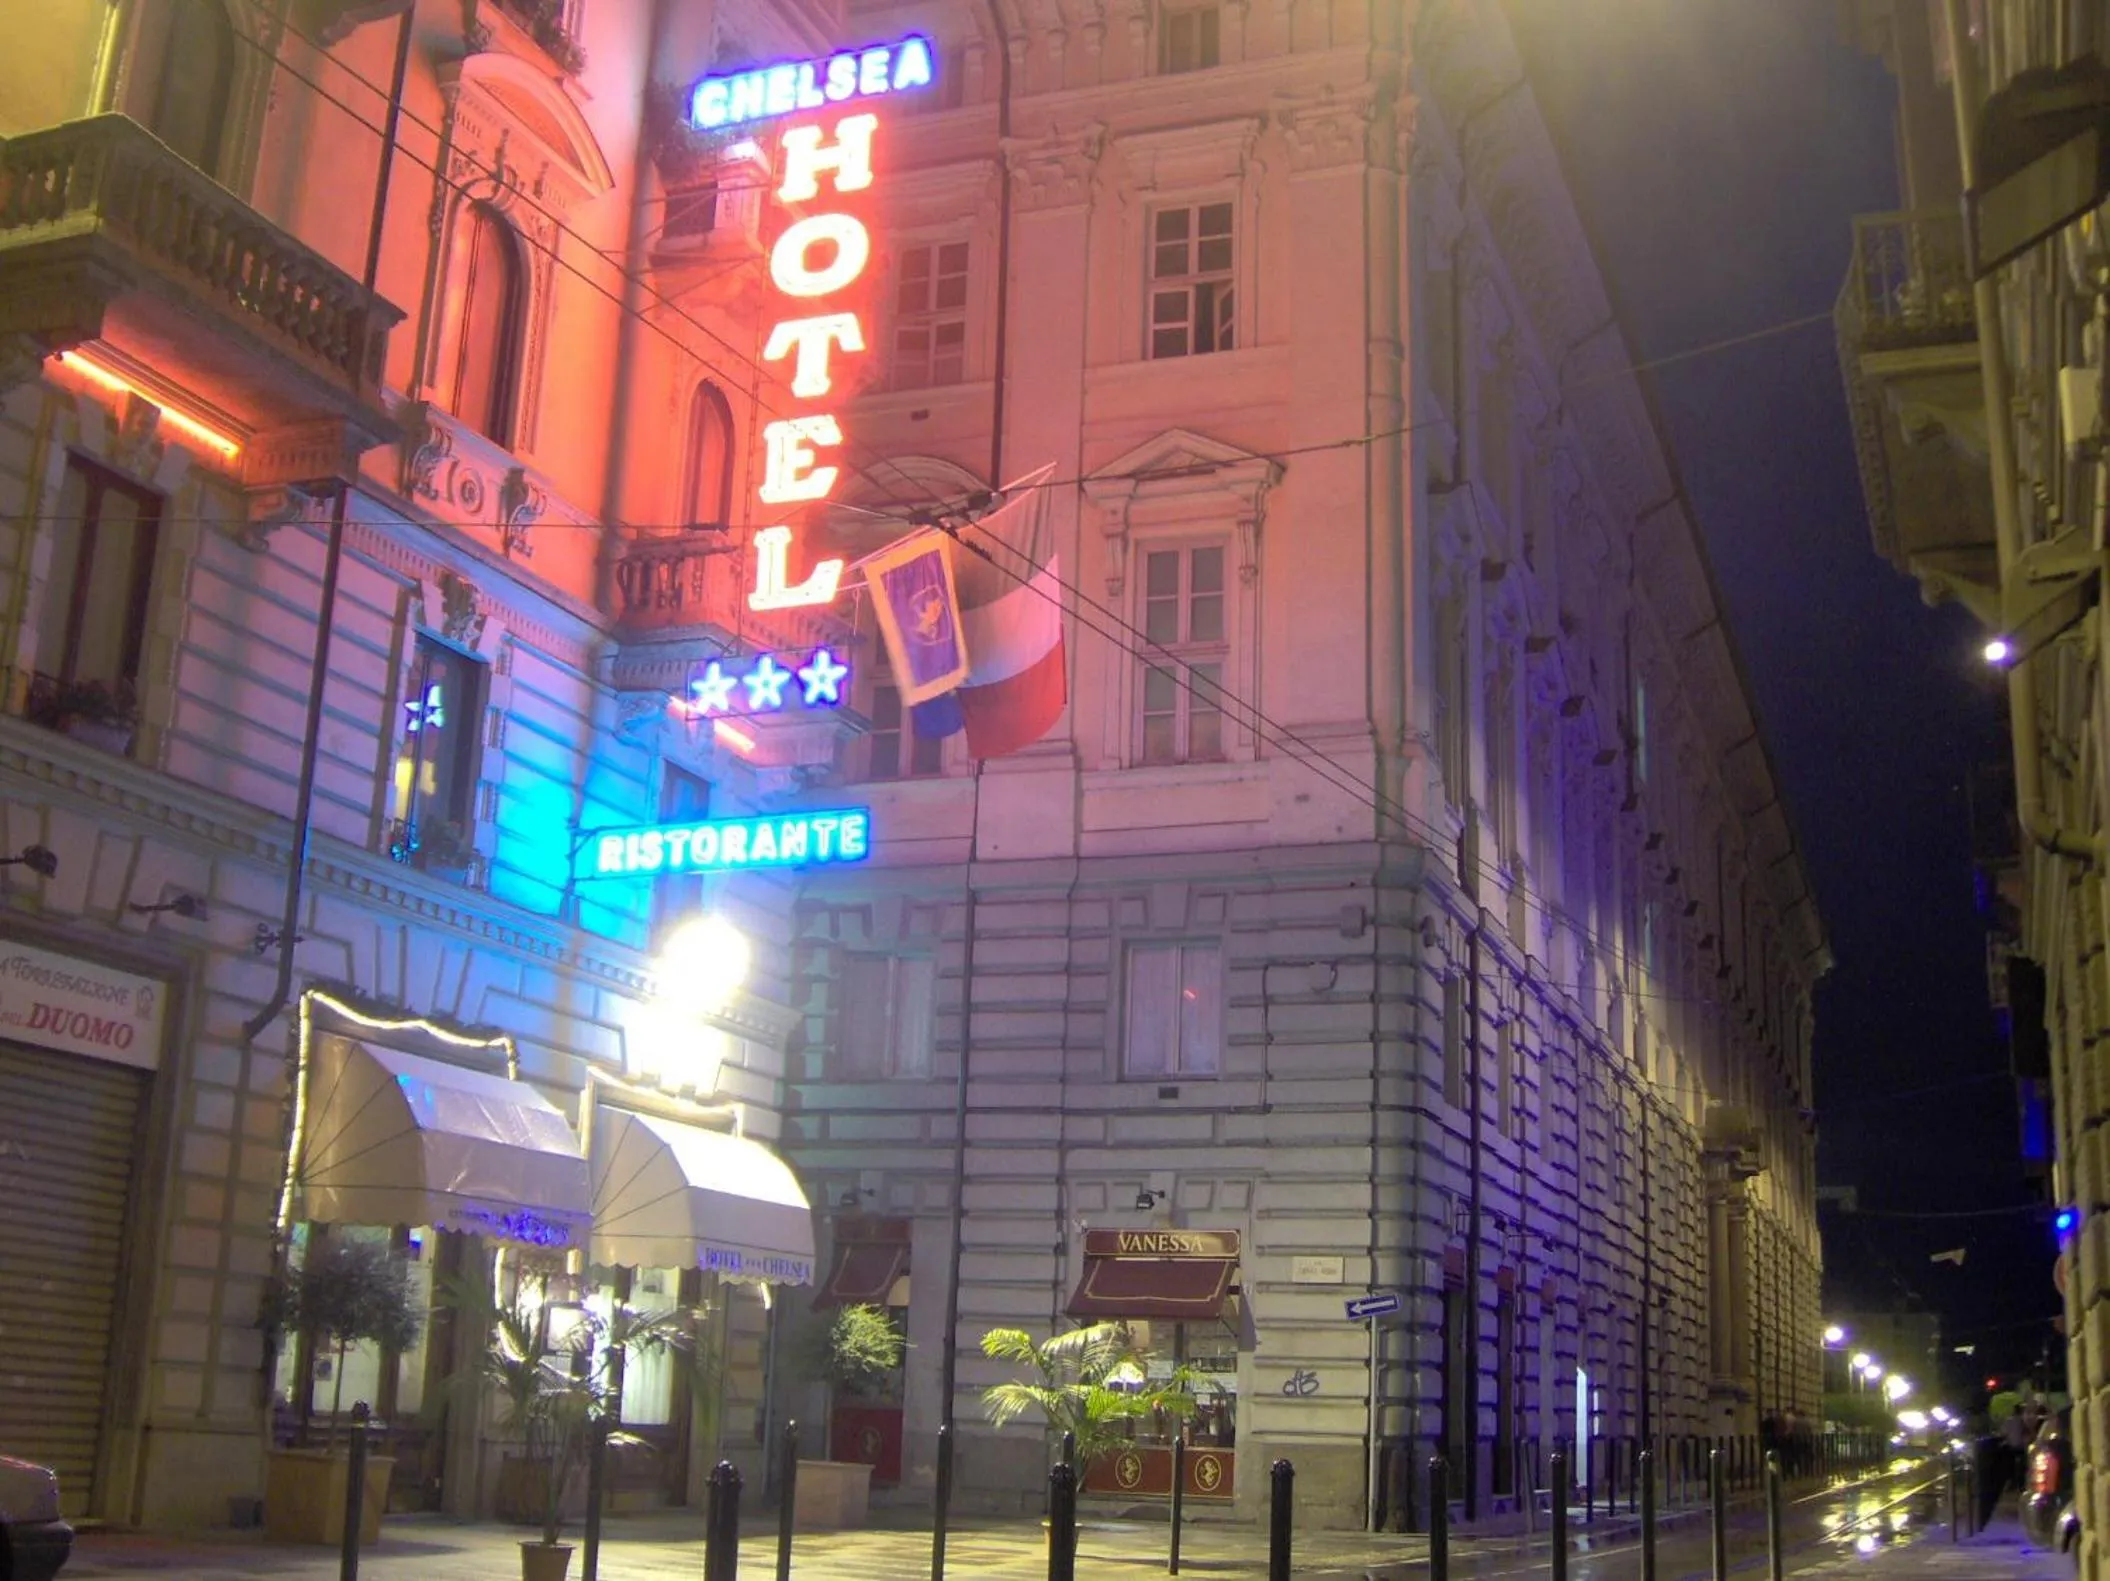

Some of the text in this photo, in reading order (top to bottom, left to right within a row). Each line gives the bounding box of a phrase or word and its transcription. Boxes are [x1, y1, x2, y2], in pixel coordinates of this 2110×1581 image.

[694, 37, 932, 127] CHELSEA
[748, 113, 879, 611] HOTEL
[597, 814, 865, 872] RISTORANTE
[26, 1002, 135, 1050] DUOMO
[762, 1256, 811, 1279] CHELSEA
[1118, 1232, 1204, 1252] VANESSA
